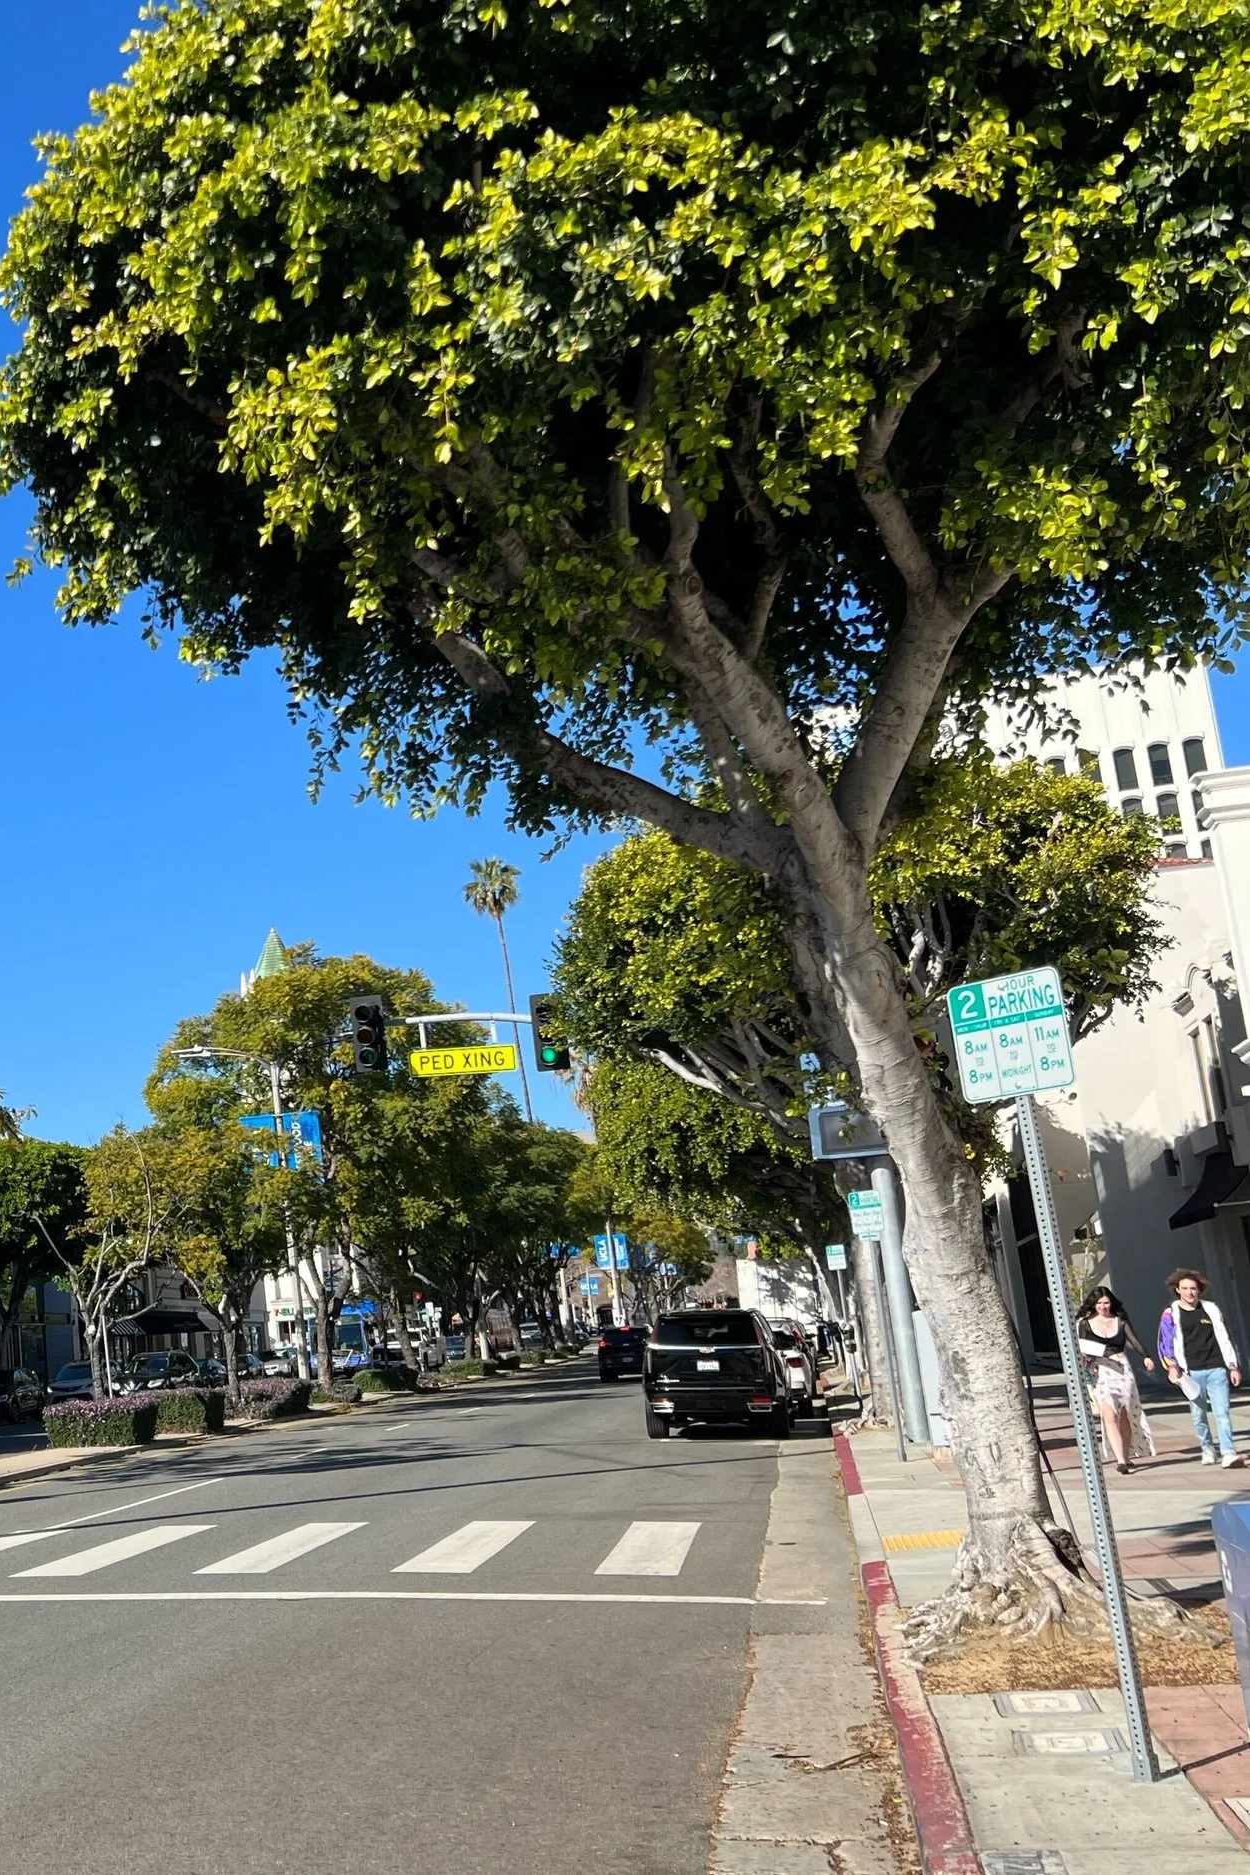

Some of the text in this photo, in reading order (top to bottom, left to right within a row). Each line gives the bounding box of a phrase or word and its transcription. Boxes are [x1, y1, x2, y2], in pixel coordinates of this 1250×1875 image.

[957, 990, 979, 1020] 2
[988, 984, 1055, 1017] PARKING
[419, 1051, 505, 1071] PED XING
[1001, 1064, 1032, 1078] MIDNIGHT
[597, 1240, 609, 1260] UCLA
